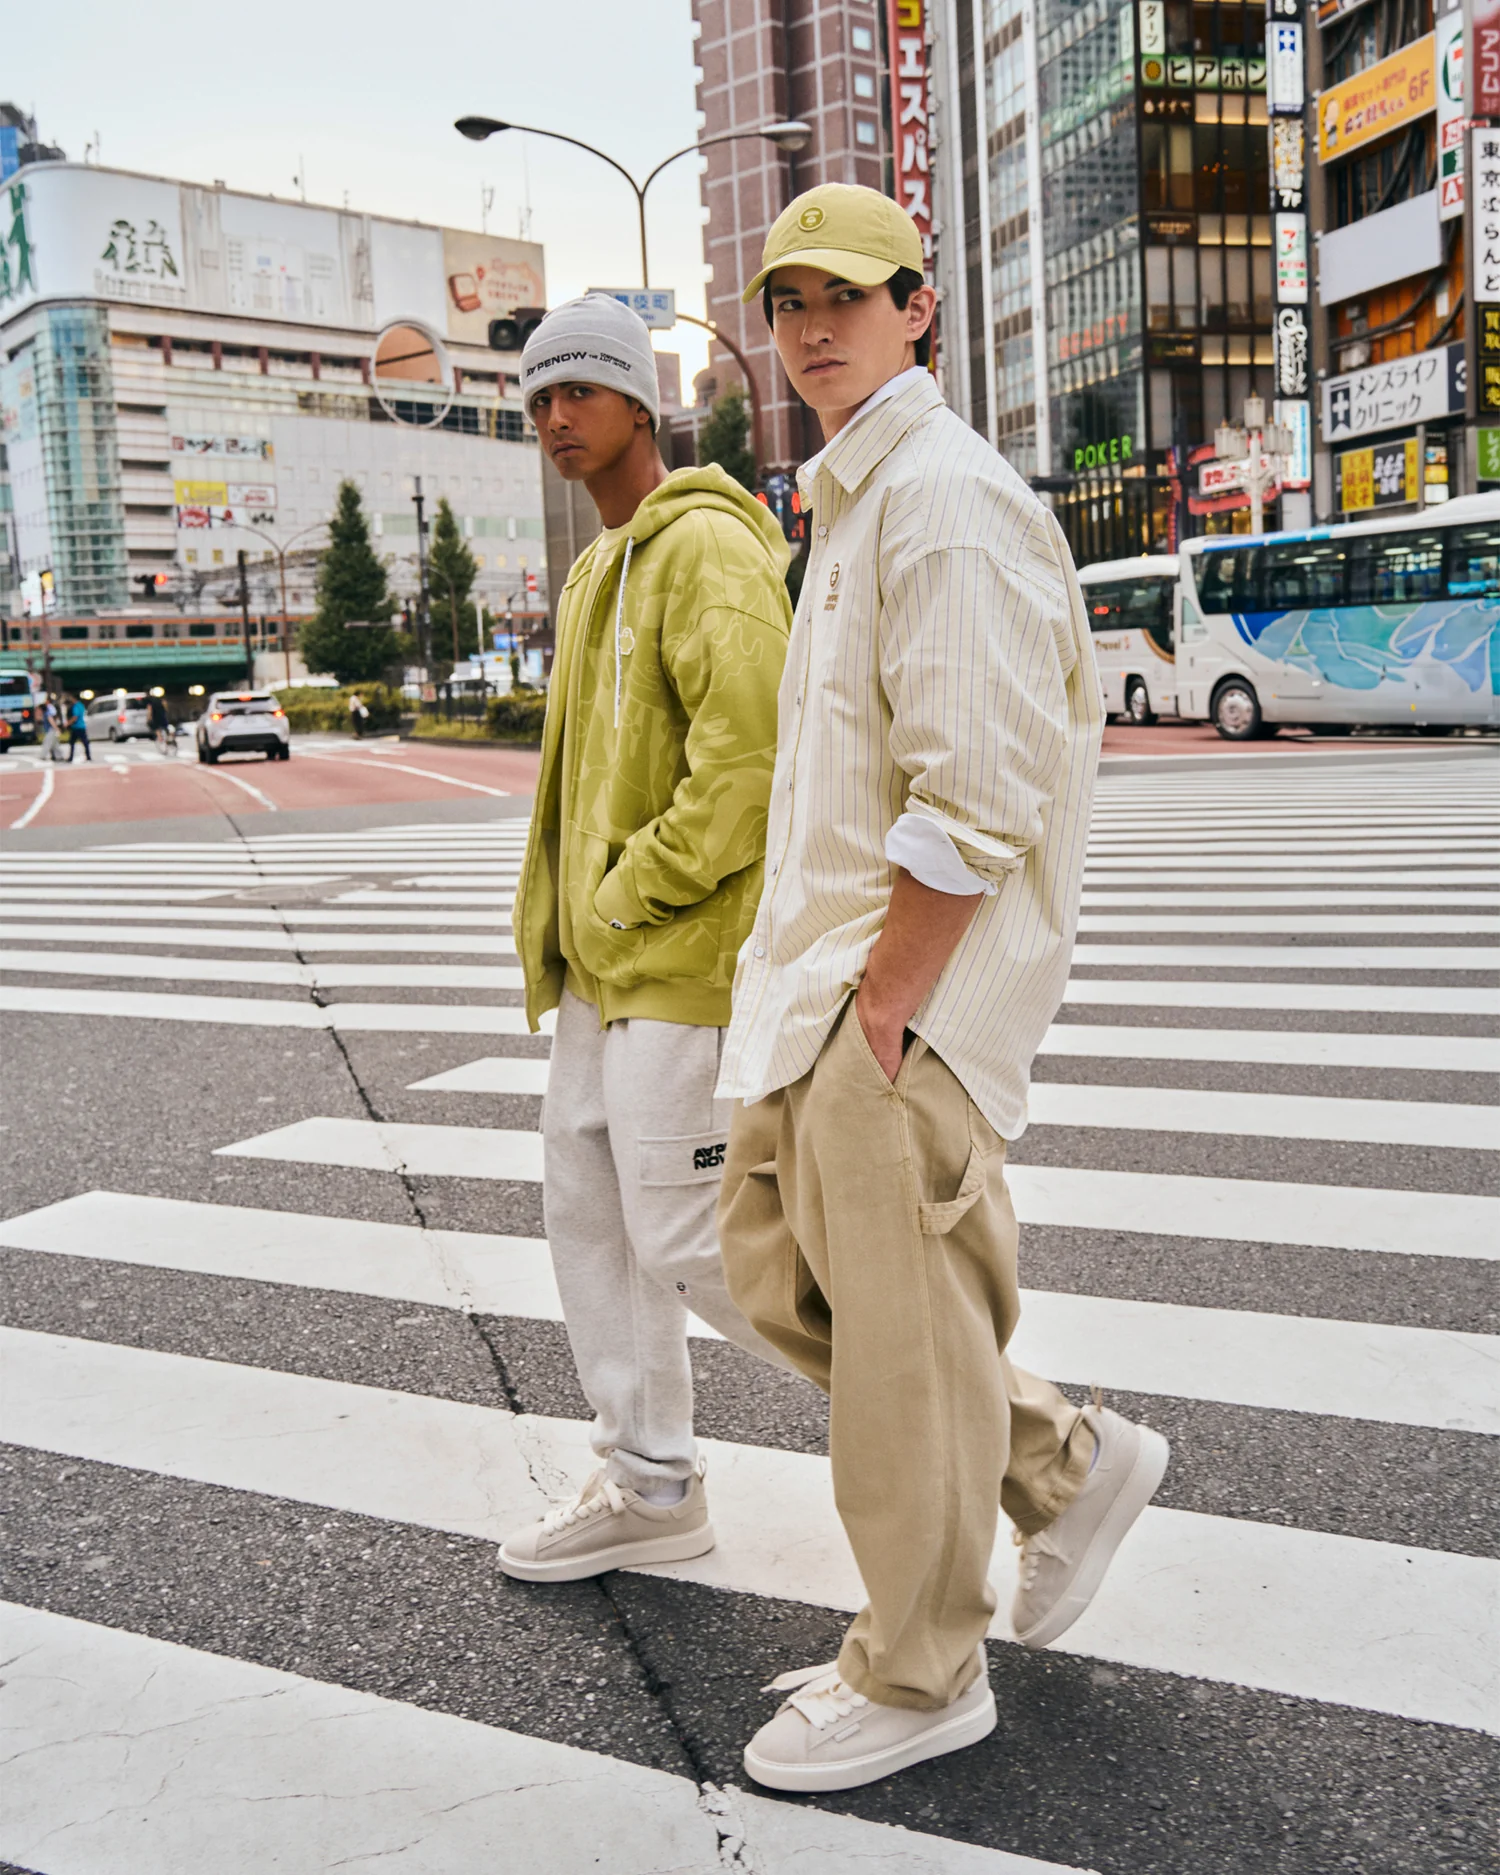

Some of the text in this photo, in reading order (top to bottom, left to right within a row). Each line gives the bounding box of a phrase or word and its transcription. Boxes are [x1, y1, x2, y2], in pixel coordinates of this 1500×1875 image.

[1480, 29, 1500, 93] アコム
[1408, 68, 1430, 103] 6F
[1060, 312, 1128, 360] BEAUTY
[1355, 357, 1437, 400] メンズライフ
[1355, 393, 1422, 430] クリニック
[1074, 434, 1132, 472] POKER
[1487, 431, 1500, 473] レイク
